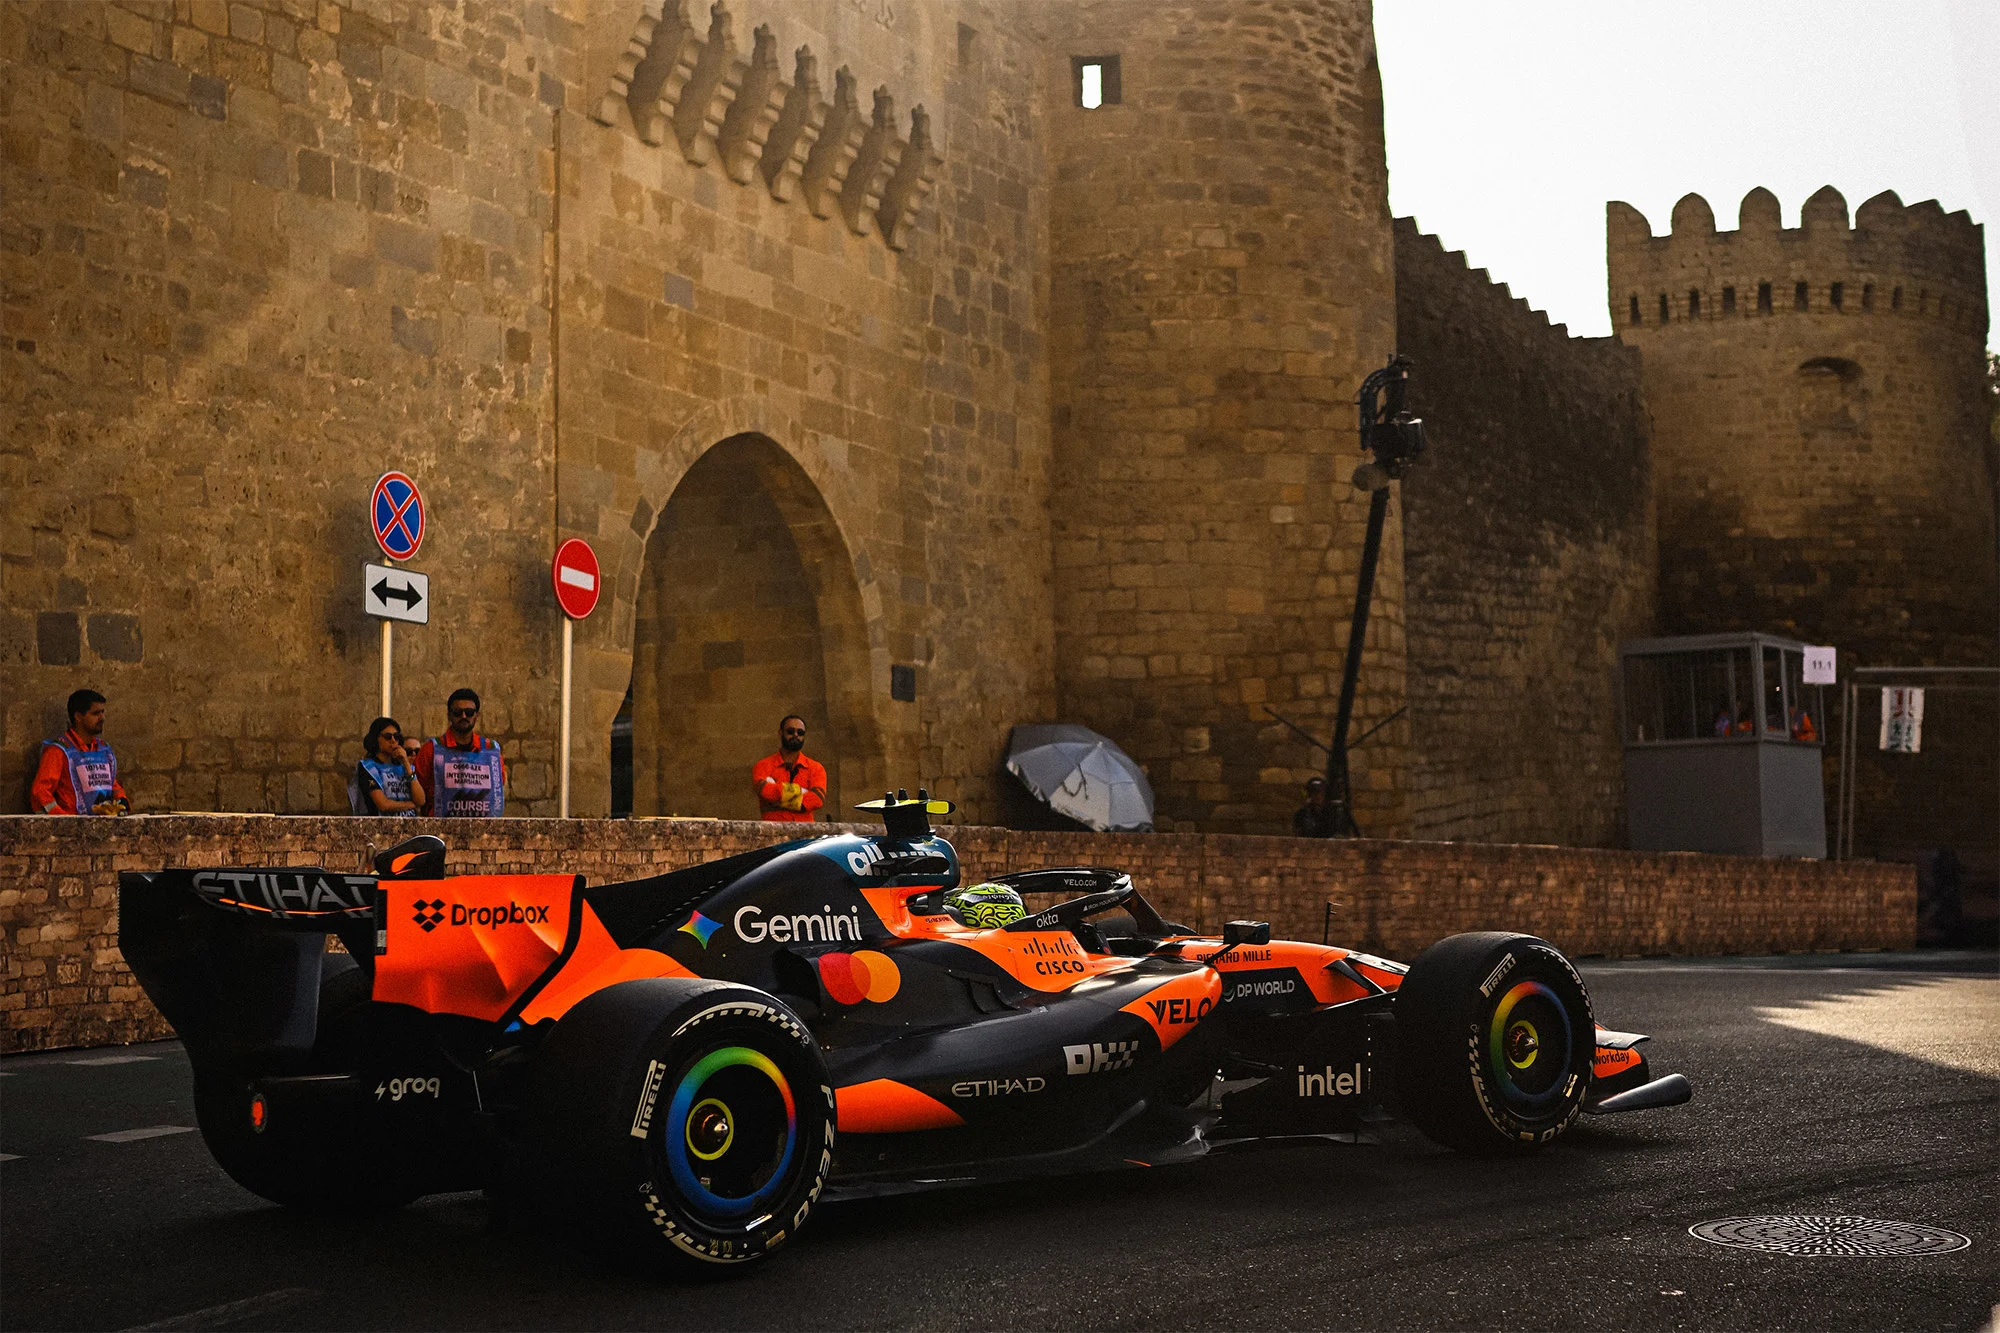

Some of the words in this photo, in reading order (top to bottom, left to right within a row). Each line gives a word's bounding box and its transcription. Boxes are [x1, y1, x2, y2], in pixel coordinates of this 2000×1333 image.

[446, 772, 489, 780] INTERVENTION
[447, 800, 490, 811] COURSE
[1063, 878, 1097, 887] VELO.COM
[451, 901, 550, 930] Dropbox
[733, 904, 863, 944] Gemini
[1036, 912, 1059, 928] okta
[1243, 949, 1272, 962] MILLE
[1035, 961, 1085, 975] CISCO
[1479, 952, 1517, 998] PIRELLI
[1236, 983, 1253, 998] DP
[1254, 979, 1295, 996] WORLD
[1146, 997, 1212, 1025] VELO
[389, 1077, 441, 1102] groq
[951, 1076, 1046, 1098] ETIHAD
[1298, 1062, 1361, 1097] intel
[630, 1059, 667, 1140] PIRELLI
[793, 1118, 835, 1231] ZERO
